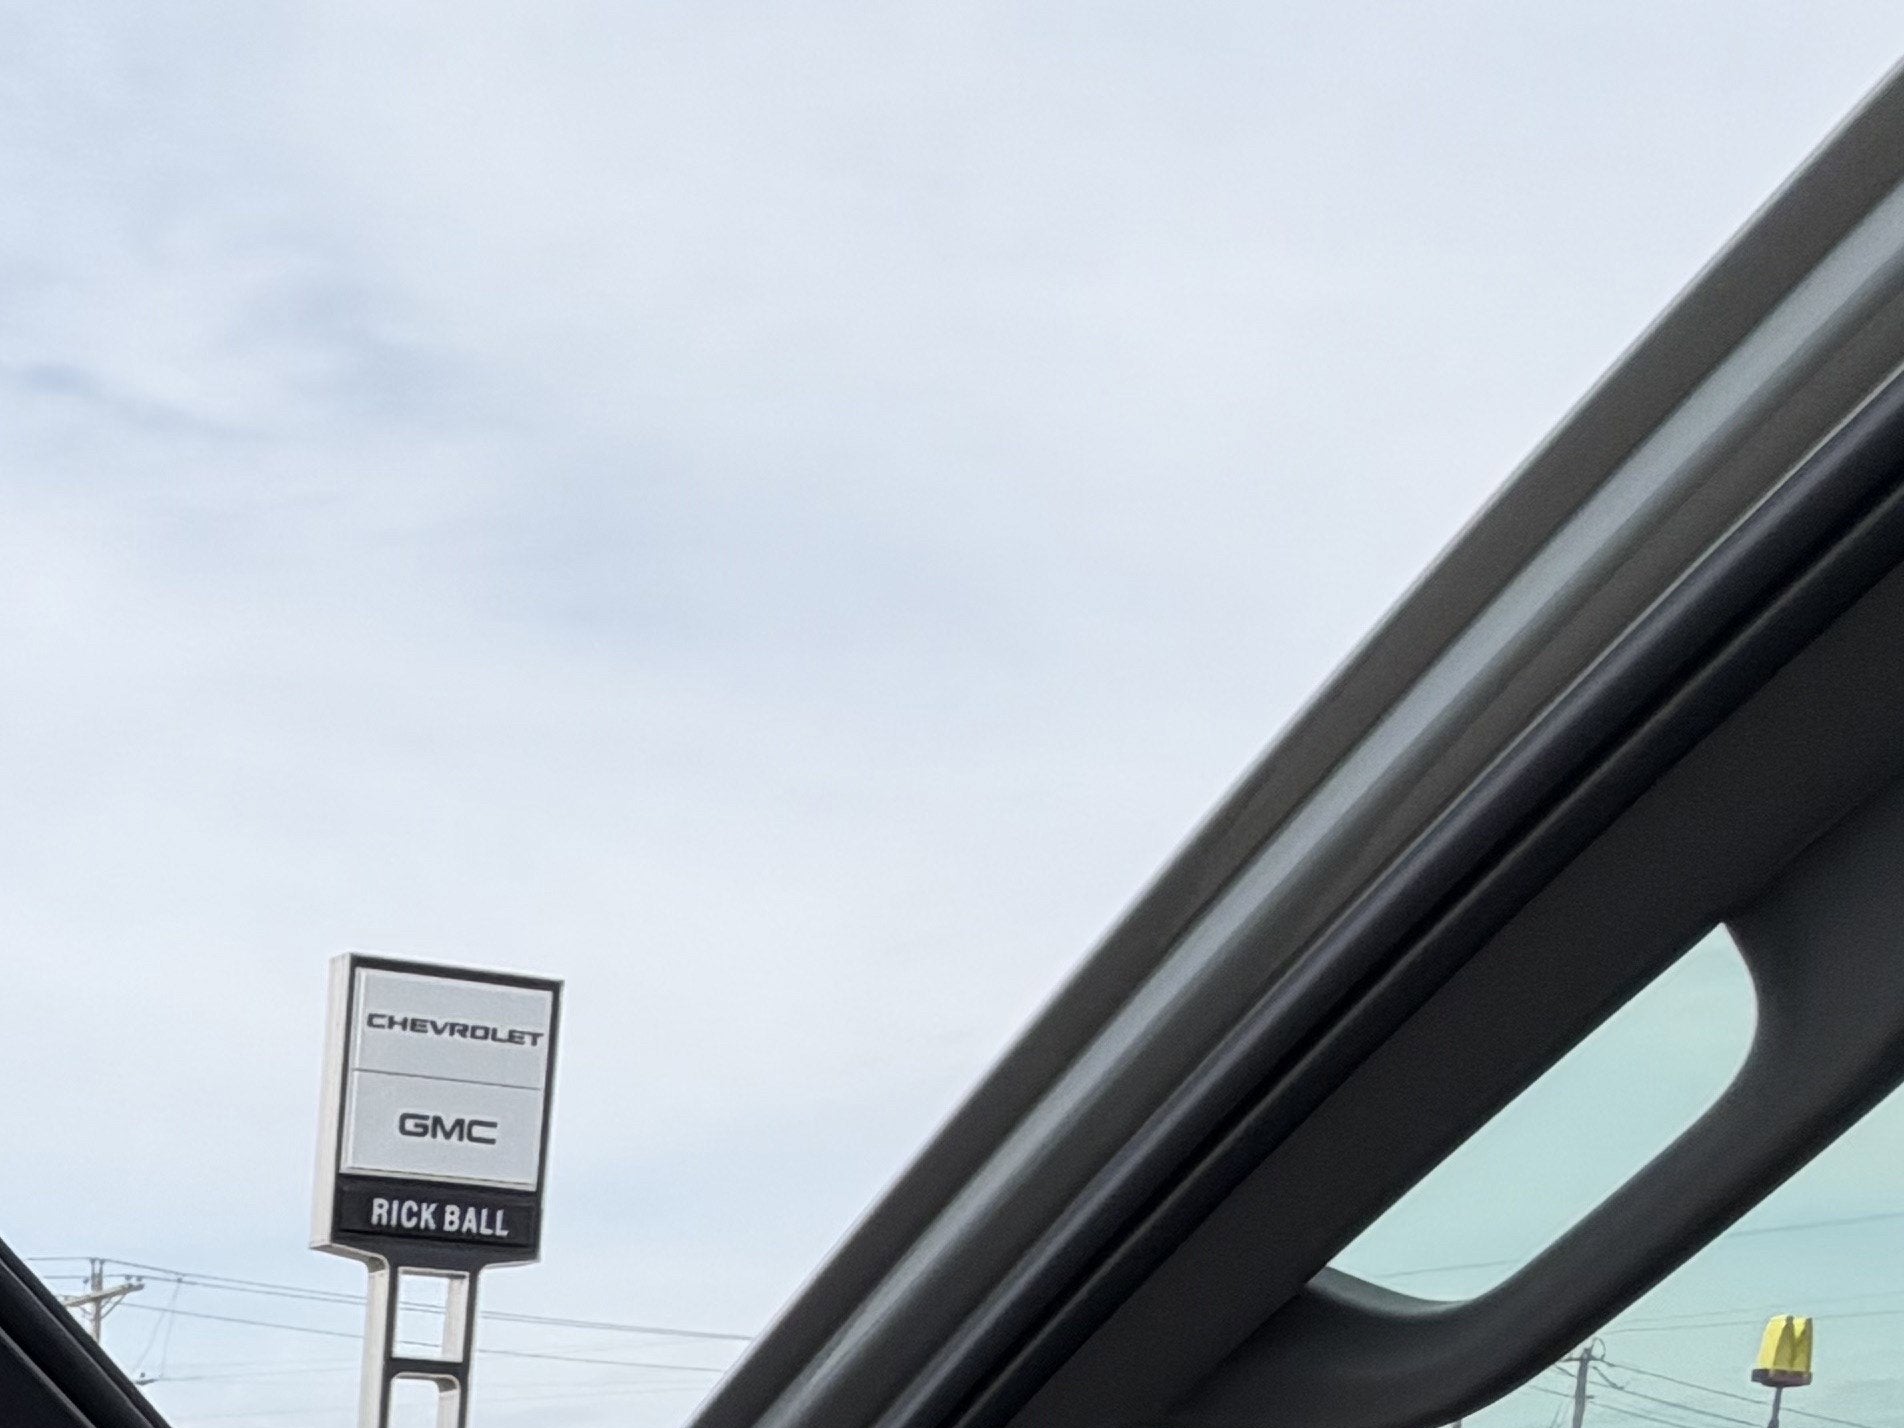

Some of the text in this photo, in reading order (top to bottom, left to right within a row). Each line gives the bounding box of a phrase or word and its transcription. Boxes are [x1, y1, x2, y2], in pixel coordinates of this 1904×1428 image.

[366, 1012, 545, 1047] CHEVROLET
[398, 1112, 498, 1146] GMC
[370, 1197, 510, 1238] RICK BALL
